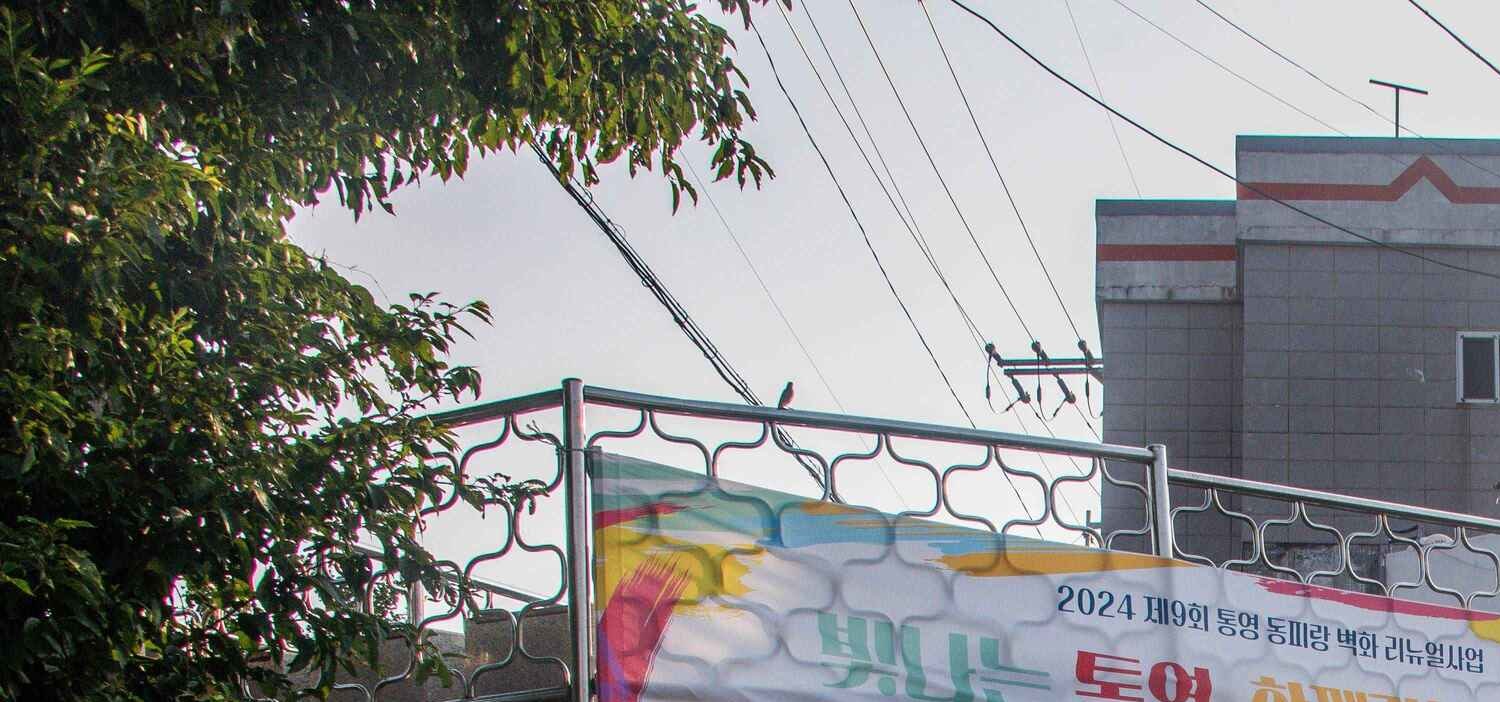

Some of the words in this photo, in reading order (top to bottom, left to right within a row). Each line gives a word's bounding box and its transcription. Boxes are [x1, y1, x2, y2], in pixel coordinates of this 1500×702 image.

[1057, 585, 1136, 620] 2024
[1143, 595, 1209, 632] 제9회
[1217, 608, 1259, 640] 통영
[1266, 616, 1331, 652] 동피랑
[1337, 628, 1380, 659] 벽화
[1385, 635, 1483, 674] 리뉴얼사업
